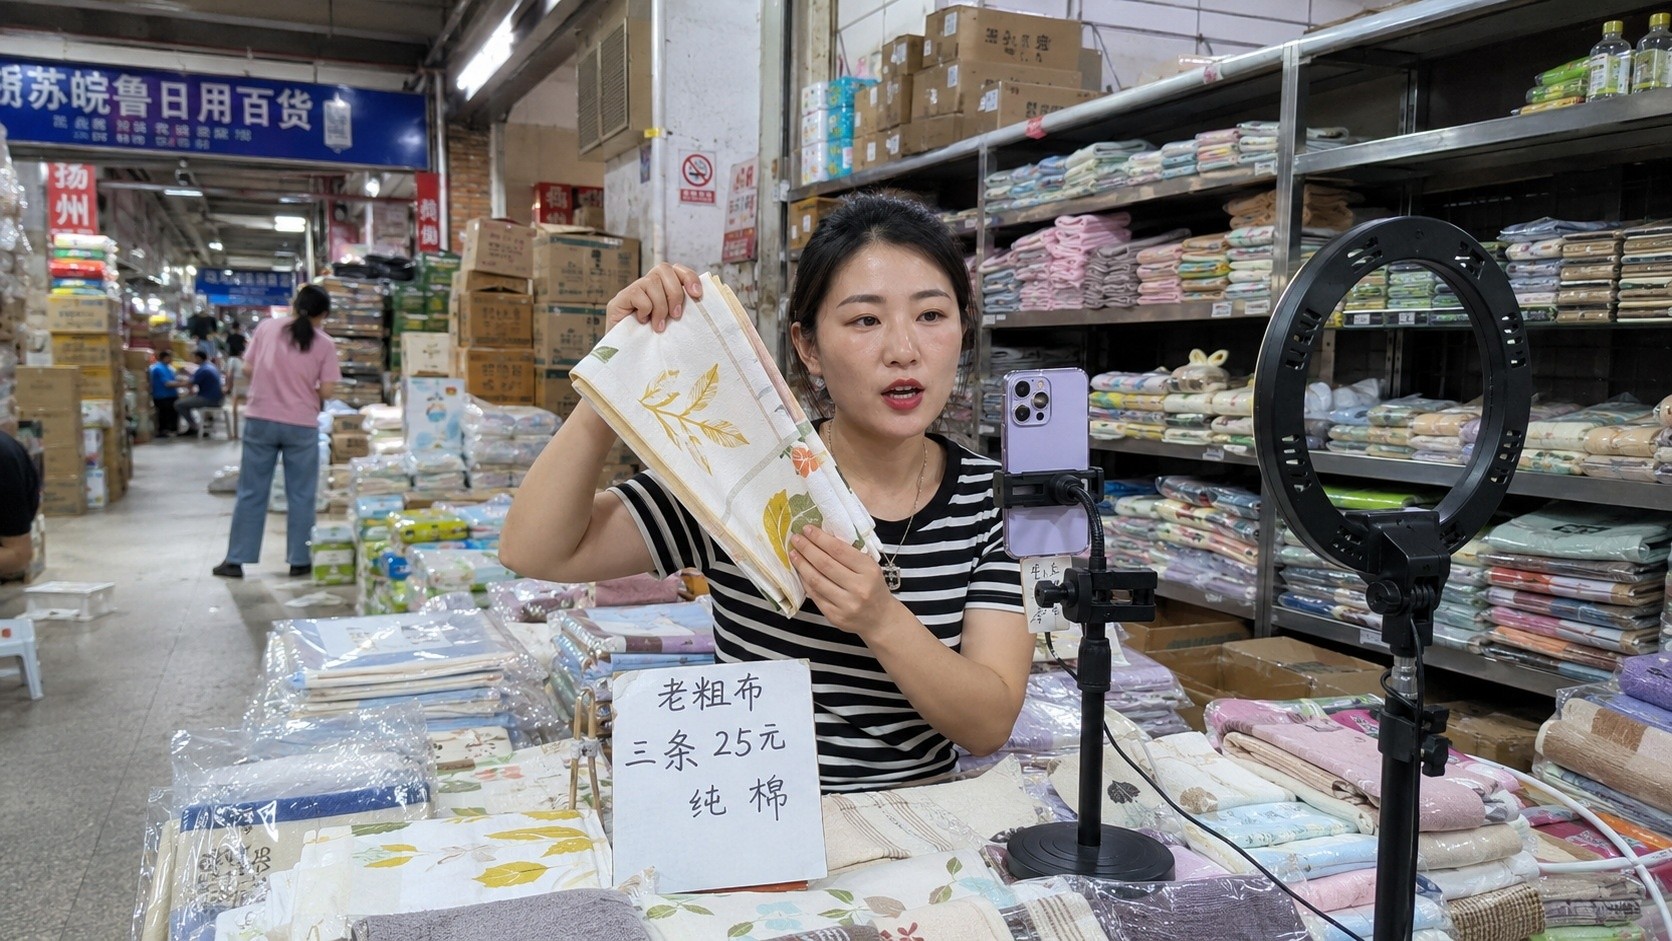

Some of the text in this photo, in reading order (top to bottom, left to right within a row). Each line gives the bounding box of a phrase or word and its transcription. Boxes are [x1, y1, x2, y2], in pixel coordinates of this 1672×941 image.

[54, 162, 89, 227] 扬州
[658, 673, 762, 711] 老粗布
[688, 774, 788, 821] 纯棉
